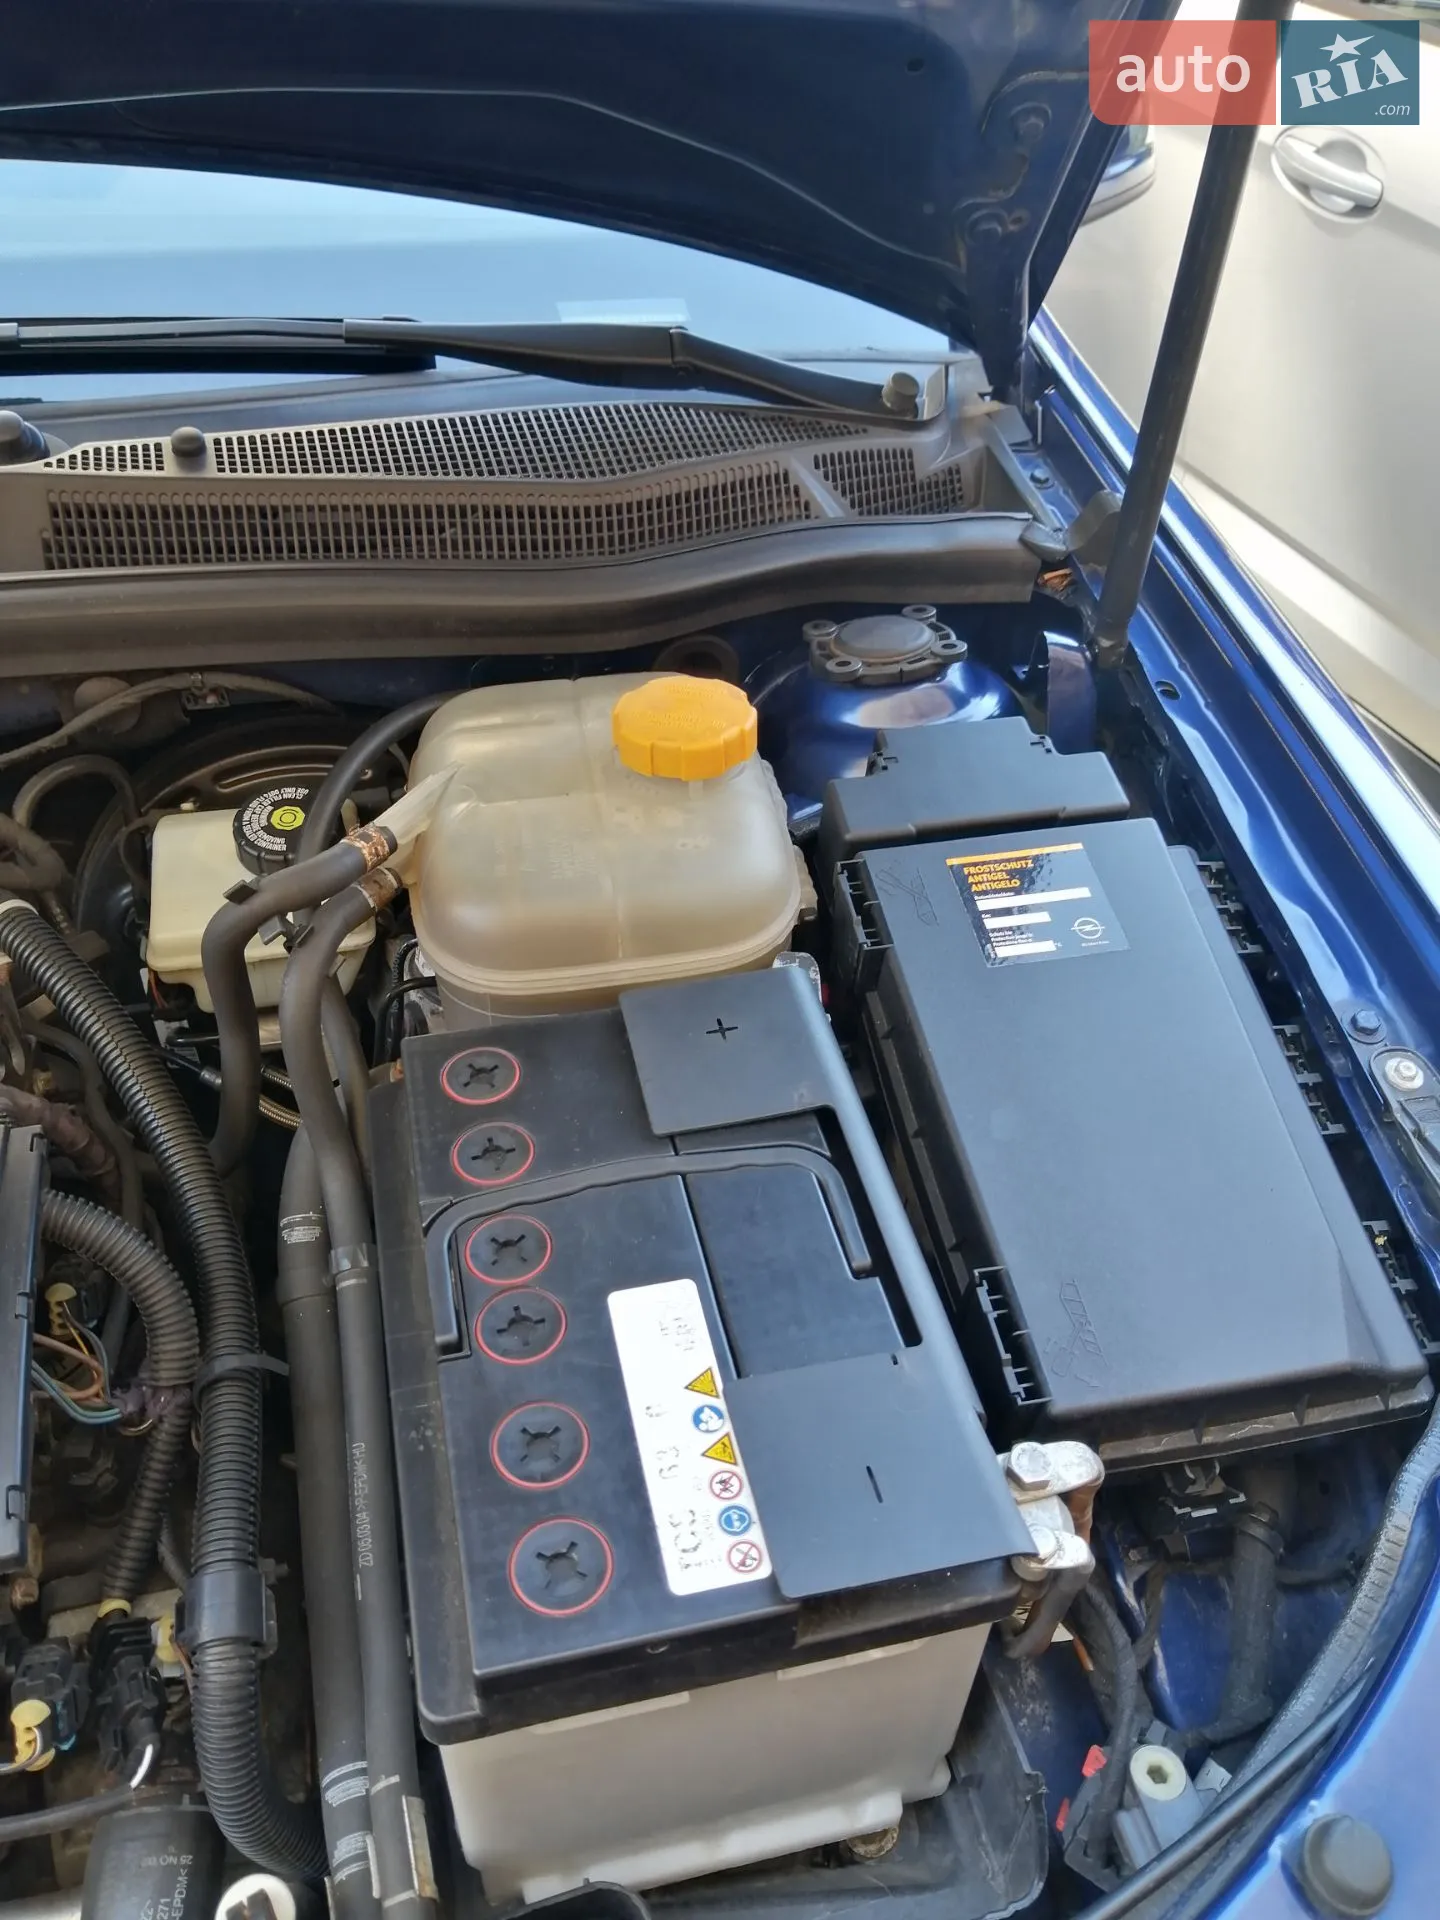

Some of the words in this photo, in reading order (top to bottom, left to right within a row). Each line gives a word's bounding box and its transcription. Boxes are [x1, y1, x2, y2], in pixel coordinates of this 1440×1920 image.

[297, 787, 309, 795] USE
[261, 794, 282, 806] FILLER
[256, 830, 286, 844] REMOVING
[254, 838, 287, 851] CONTAINER
[963, 859, 1034, 876] FROSTSCHUTZ
[967, 871, 1010, 884] ANTIGEL
[971, 878, 1020, 892] ANTIGELO
